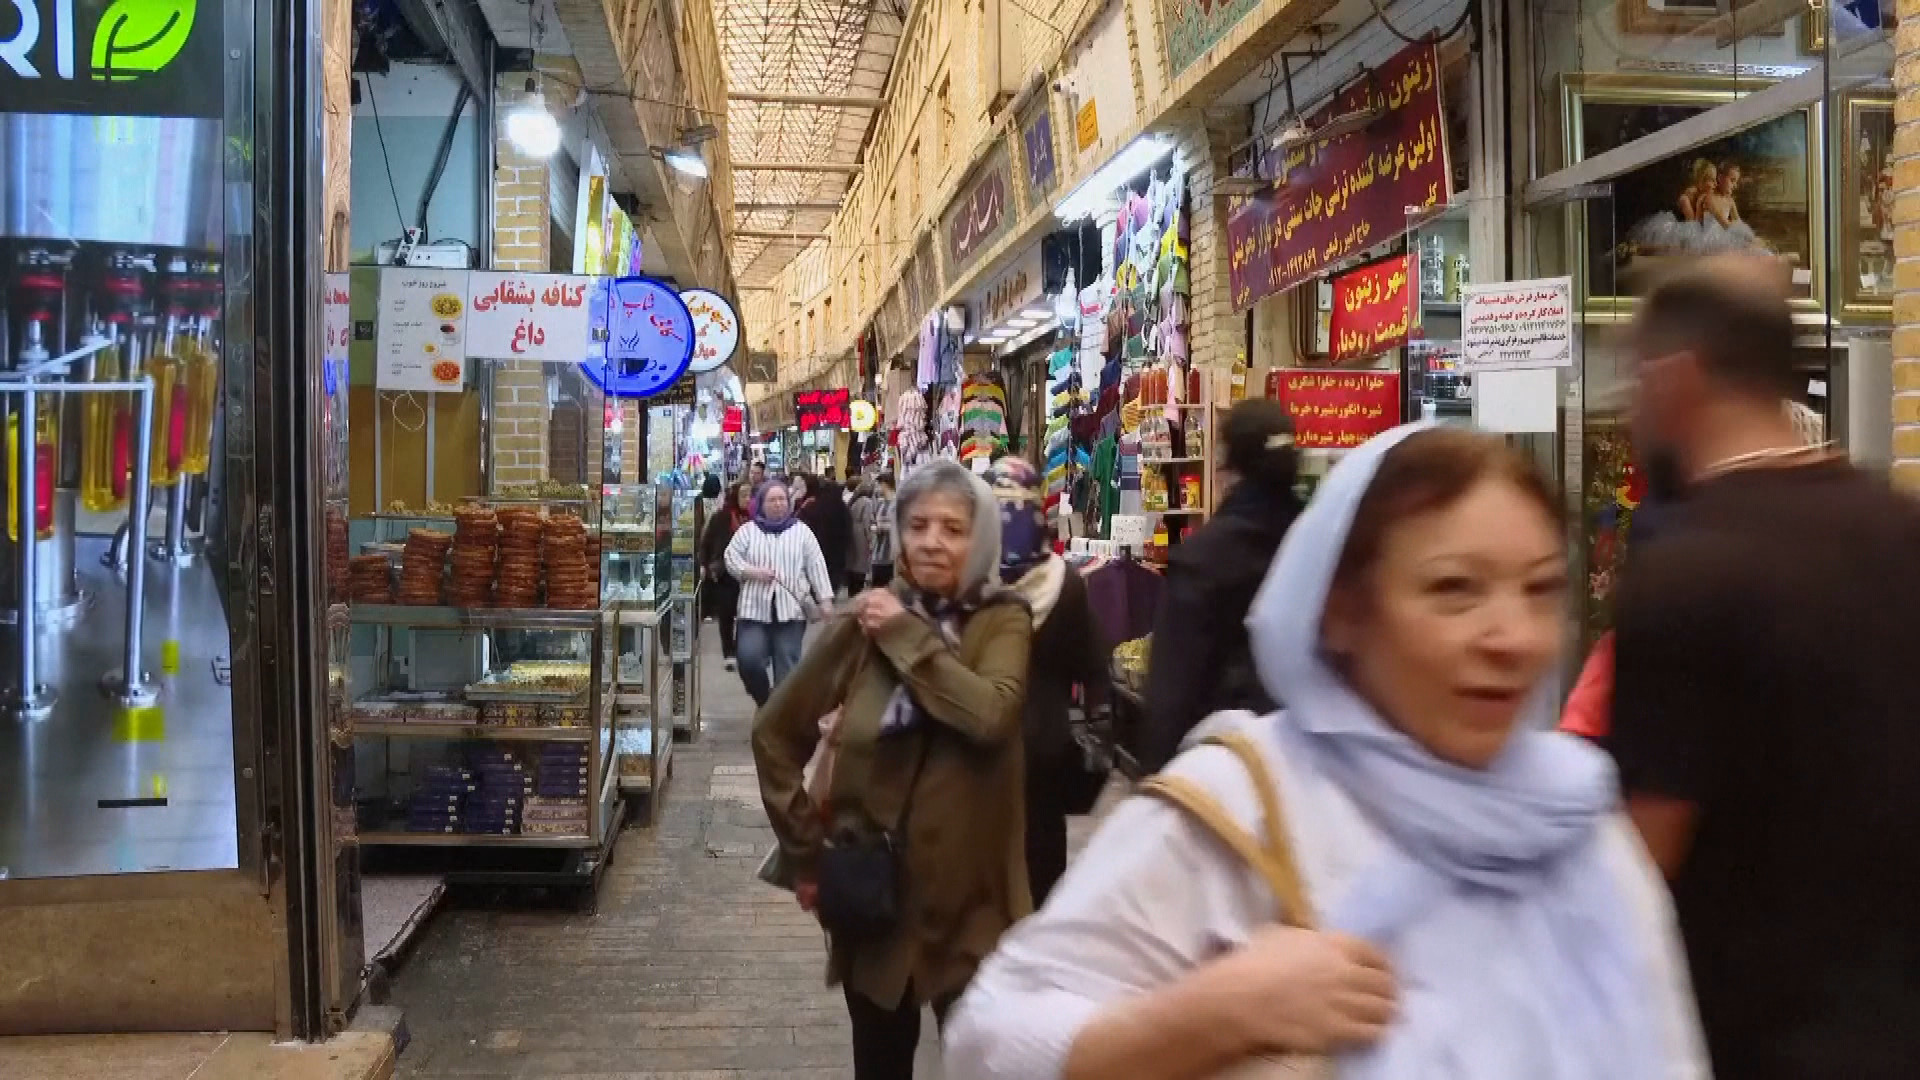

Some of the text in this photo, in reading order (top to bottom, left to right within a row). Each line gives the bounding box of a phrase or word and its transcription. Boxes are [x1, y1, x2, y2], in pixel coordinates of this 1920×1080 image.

[1389, 51, 1433, 109] زیتون
[1232, 114, 1437, 271] اولین عرضه کننده ترشی جات سنتی در بازار تجریش
[1356, 219, 1371, 244] حاج
[473, 279, 535, 313] بشقابی
[541, 280, 587, 308] کنافه
[1345, 257, 1408, 313] شهر زیتون
[511, 318, 545, 353] داغ
[1375, 305, 1408, 343] قیمت
[1335, 328, 1371, 361] رودبار
[1317, 375, 1336, 391] حلوا
[1344, 375, 1363, 391] ارده
[1366, 375, 1384, 391] حلوا
[1290, 401, 1312, 417] خرما
[1362, 403, 1383, 418] شیره
